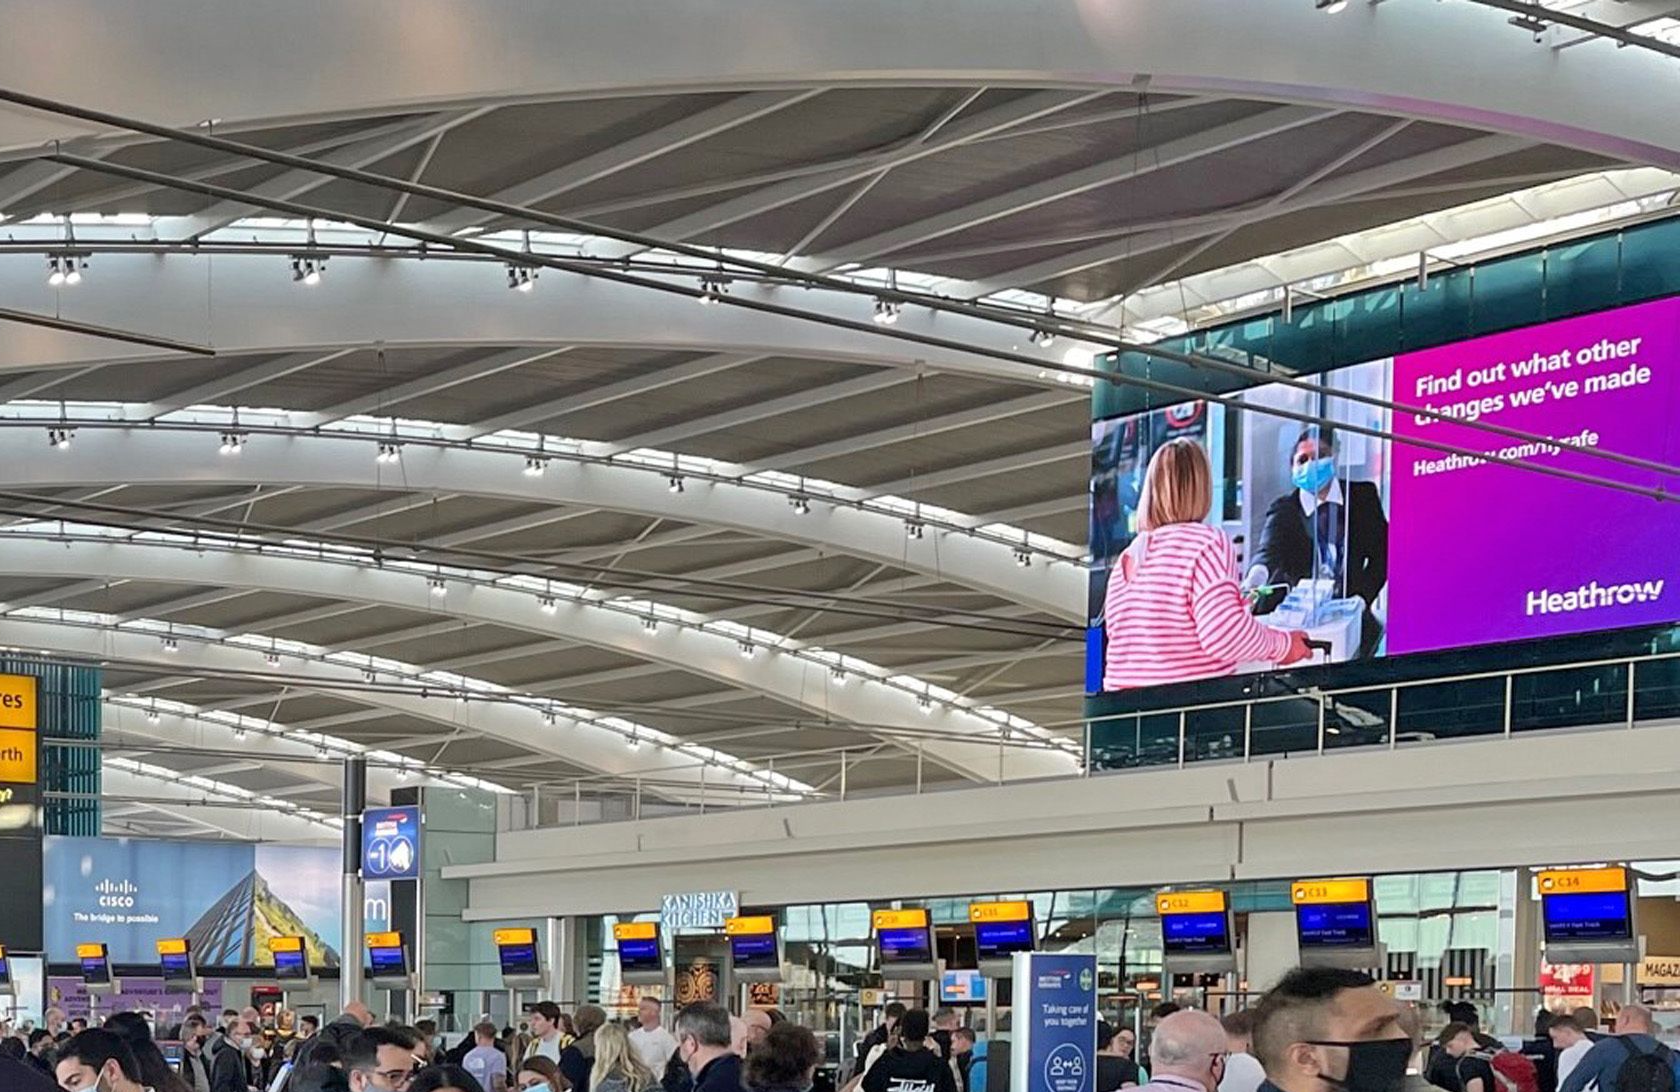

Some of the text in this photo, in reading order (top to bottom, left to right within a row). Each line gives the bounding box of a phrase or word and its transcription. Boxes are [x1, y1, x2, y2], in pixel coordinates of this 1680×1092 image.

[1416, 337, 1642, 398] Find out what other
[1509, 380, 1579, 408] we've
[1584, 364, 1652, 394] made
[1526, 577, 1665, 617] Heathrow
[99, 895, 134, 908] CISCO
[661, 890, 737, 911] KANISHKA
[73, 912, 89, 922] The
[89, 913, 116, 924] bridge
[126, 914, 160, 924] possible
[660, 909, 722, 929] KITCHEN
[1042, 1003, 1068, 1016] Taking
[1044, 1016, 1088, 1028] you together
